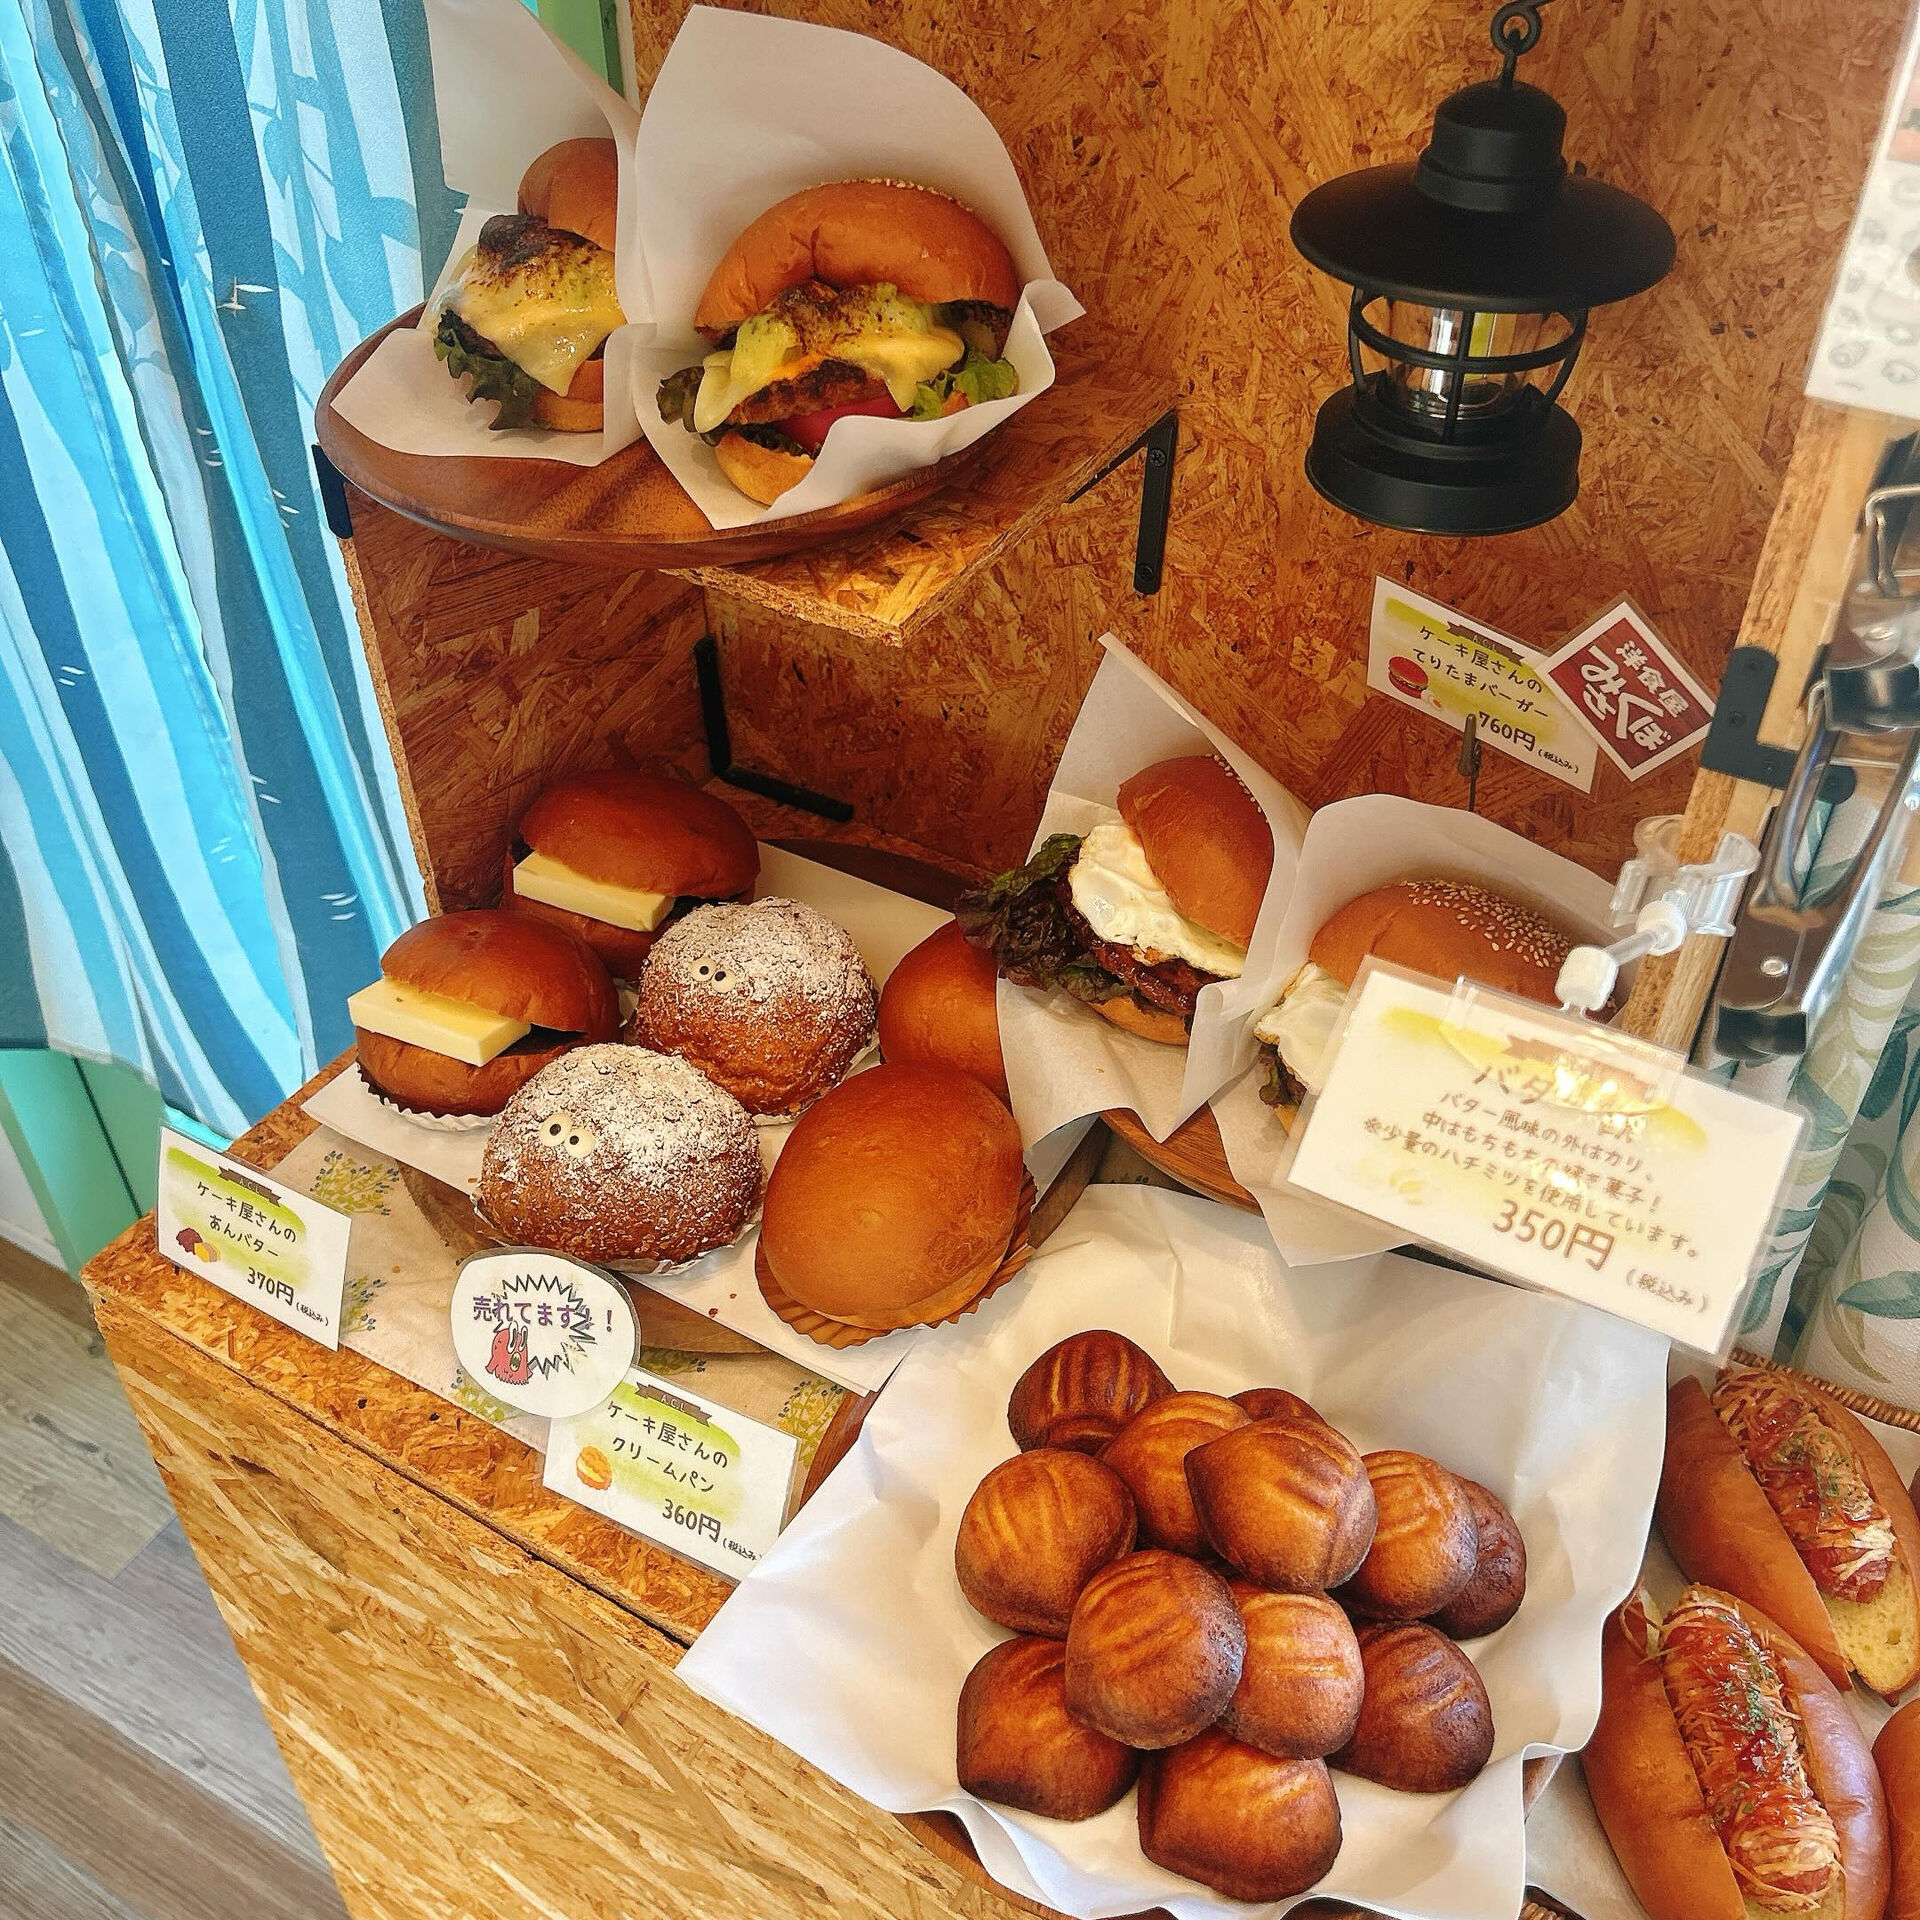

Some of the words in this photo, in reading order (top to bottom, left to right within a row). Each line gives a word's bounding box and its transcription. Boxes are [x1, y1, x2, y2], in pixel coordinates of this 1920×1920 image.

[1412, 647, 1549, 718] てりたまバーガー
[1419, 625, 1544, 695] ケーキ屋さんの
[1615, 640, 1690, 718] 洋食屋
[1581, 644, 1672, 750] みさくぼ
[1478, 710, 1536, 752] 760円
[197, 1181, 297, 1243] ケーキ屋さんの
[209, 1213, 279, 1257] あんバター
[1491, 1197, 1616, 1272] 350円
[246, 1266, 295, 1307] 370円
[607, 1400, 729, 1469] ケーキ屋さんの
[611, 1436, 715, 1493] クリームパン
[662, 1498, 722, 1543] 360円
